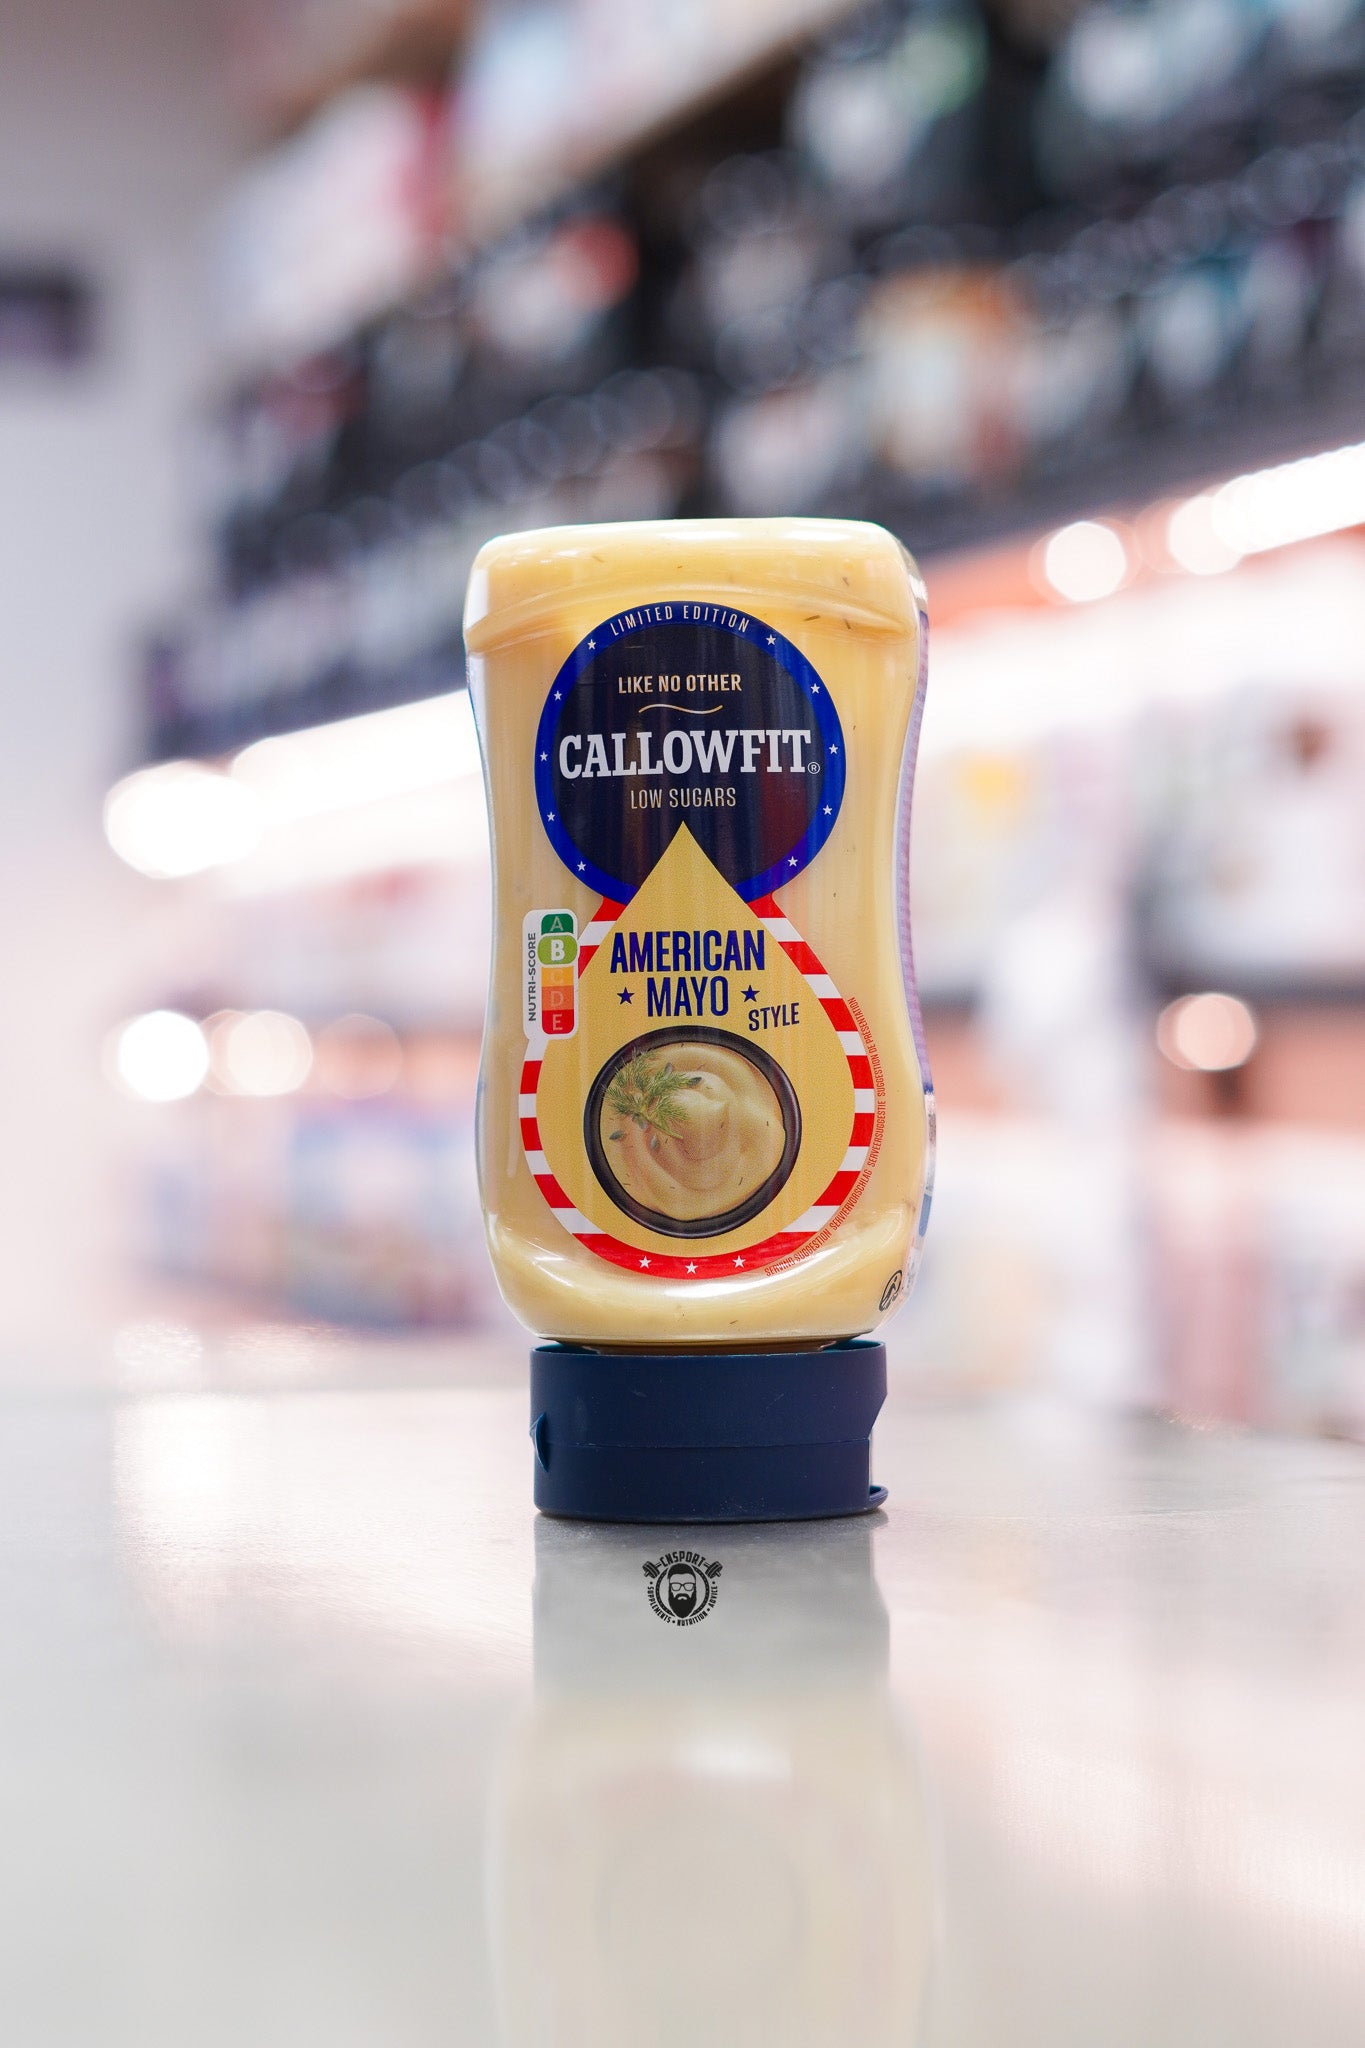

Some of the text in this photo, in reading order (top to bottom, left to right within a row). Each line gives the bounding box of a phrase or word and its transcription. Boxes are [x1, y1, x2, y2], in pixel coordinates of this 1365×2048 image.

[610, 605, 750, 635] LIMITED EDITION
[618, 674, 742, 694] LIKE NO OTHER
[630, 787, 736, 809] LOW SUGARS
[550, 915, 564, 932] A
[550, 939, 566, 962] B
[610, 929, 766, 974] AMERICAN
[527, 932, 537, 1022] NUTRI-SCORE
[550, 990, 565, 1008] D
[646, 975, 729, 1018] MAYO
[552, 1013, 563, 1031] E
[748, 1002, 800, 1032] STYLE
[867, 1043, 878, 1054] DE
[870, 1054, 885, 1097] SUGGESTION
[793, 1228, 832, 1263] SUGGESTION
[764, 1256, 796, 1277] SERVING
